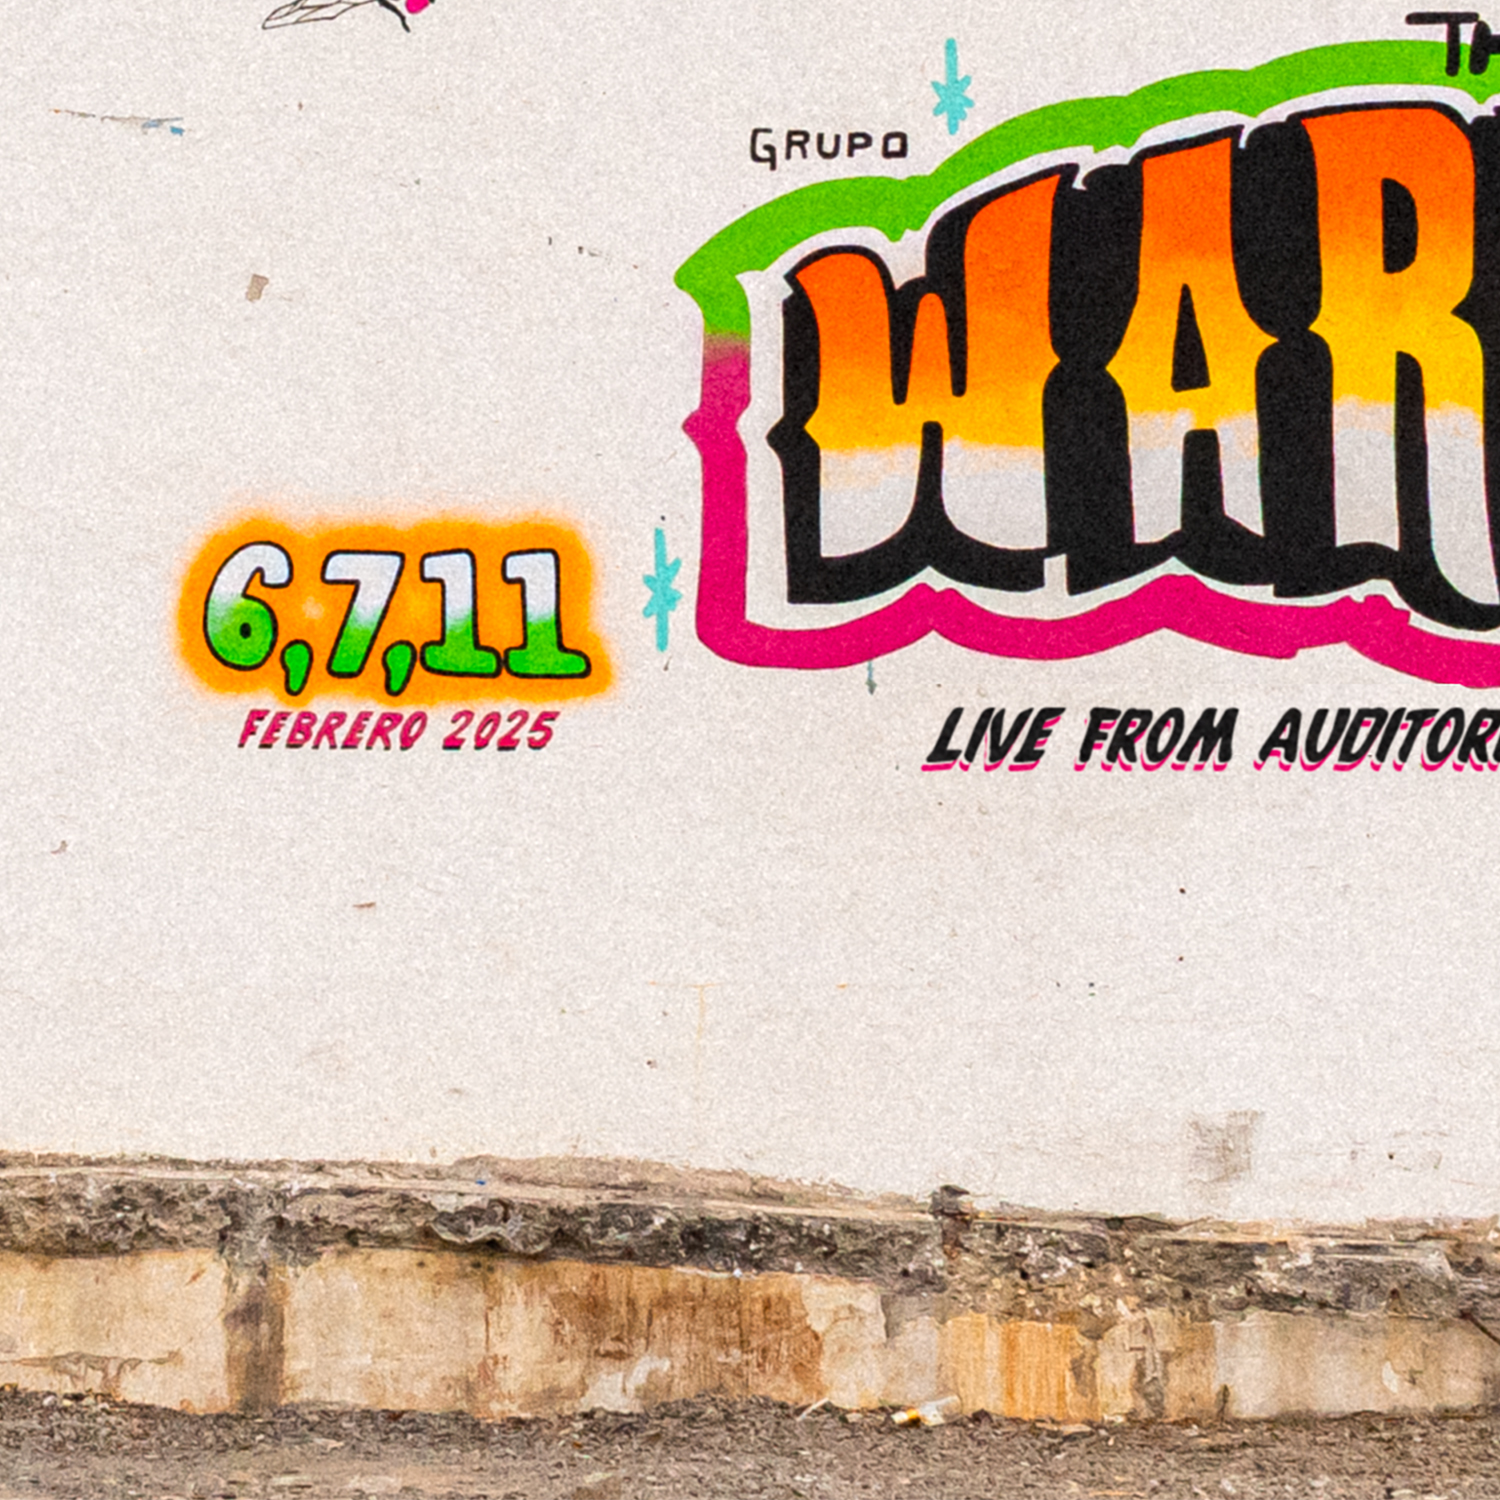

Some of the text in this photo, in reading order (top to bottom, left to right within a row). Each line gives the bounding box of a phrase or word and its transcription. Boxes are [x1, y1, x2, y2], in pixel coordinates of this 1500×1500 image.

[750, 128, 908, 171] GRUPO
[203, 541, 592, 695] 6,7,11
[238, 709, 561, 750] FEBRERO 2025
[921, 707, 1066, 772] LIVE
[1074, 707, 1239, 772] FROM
